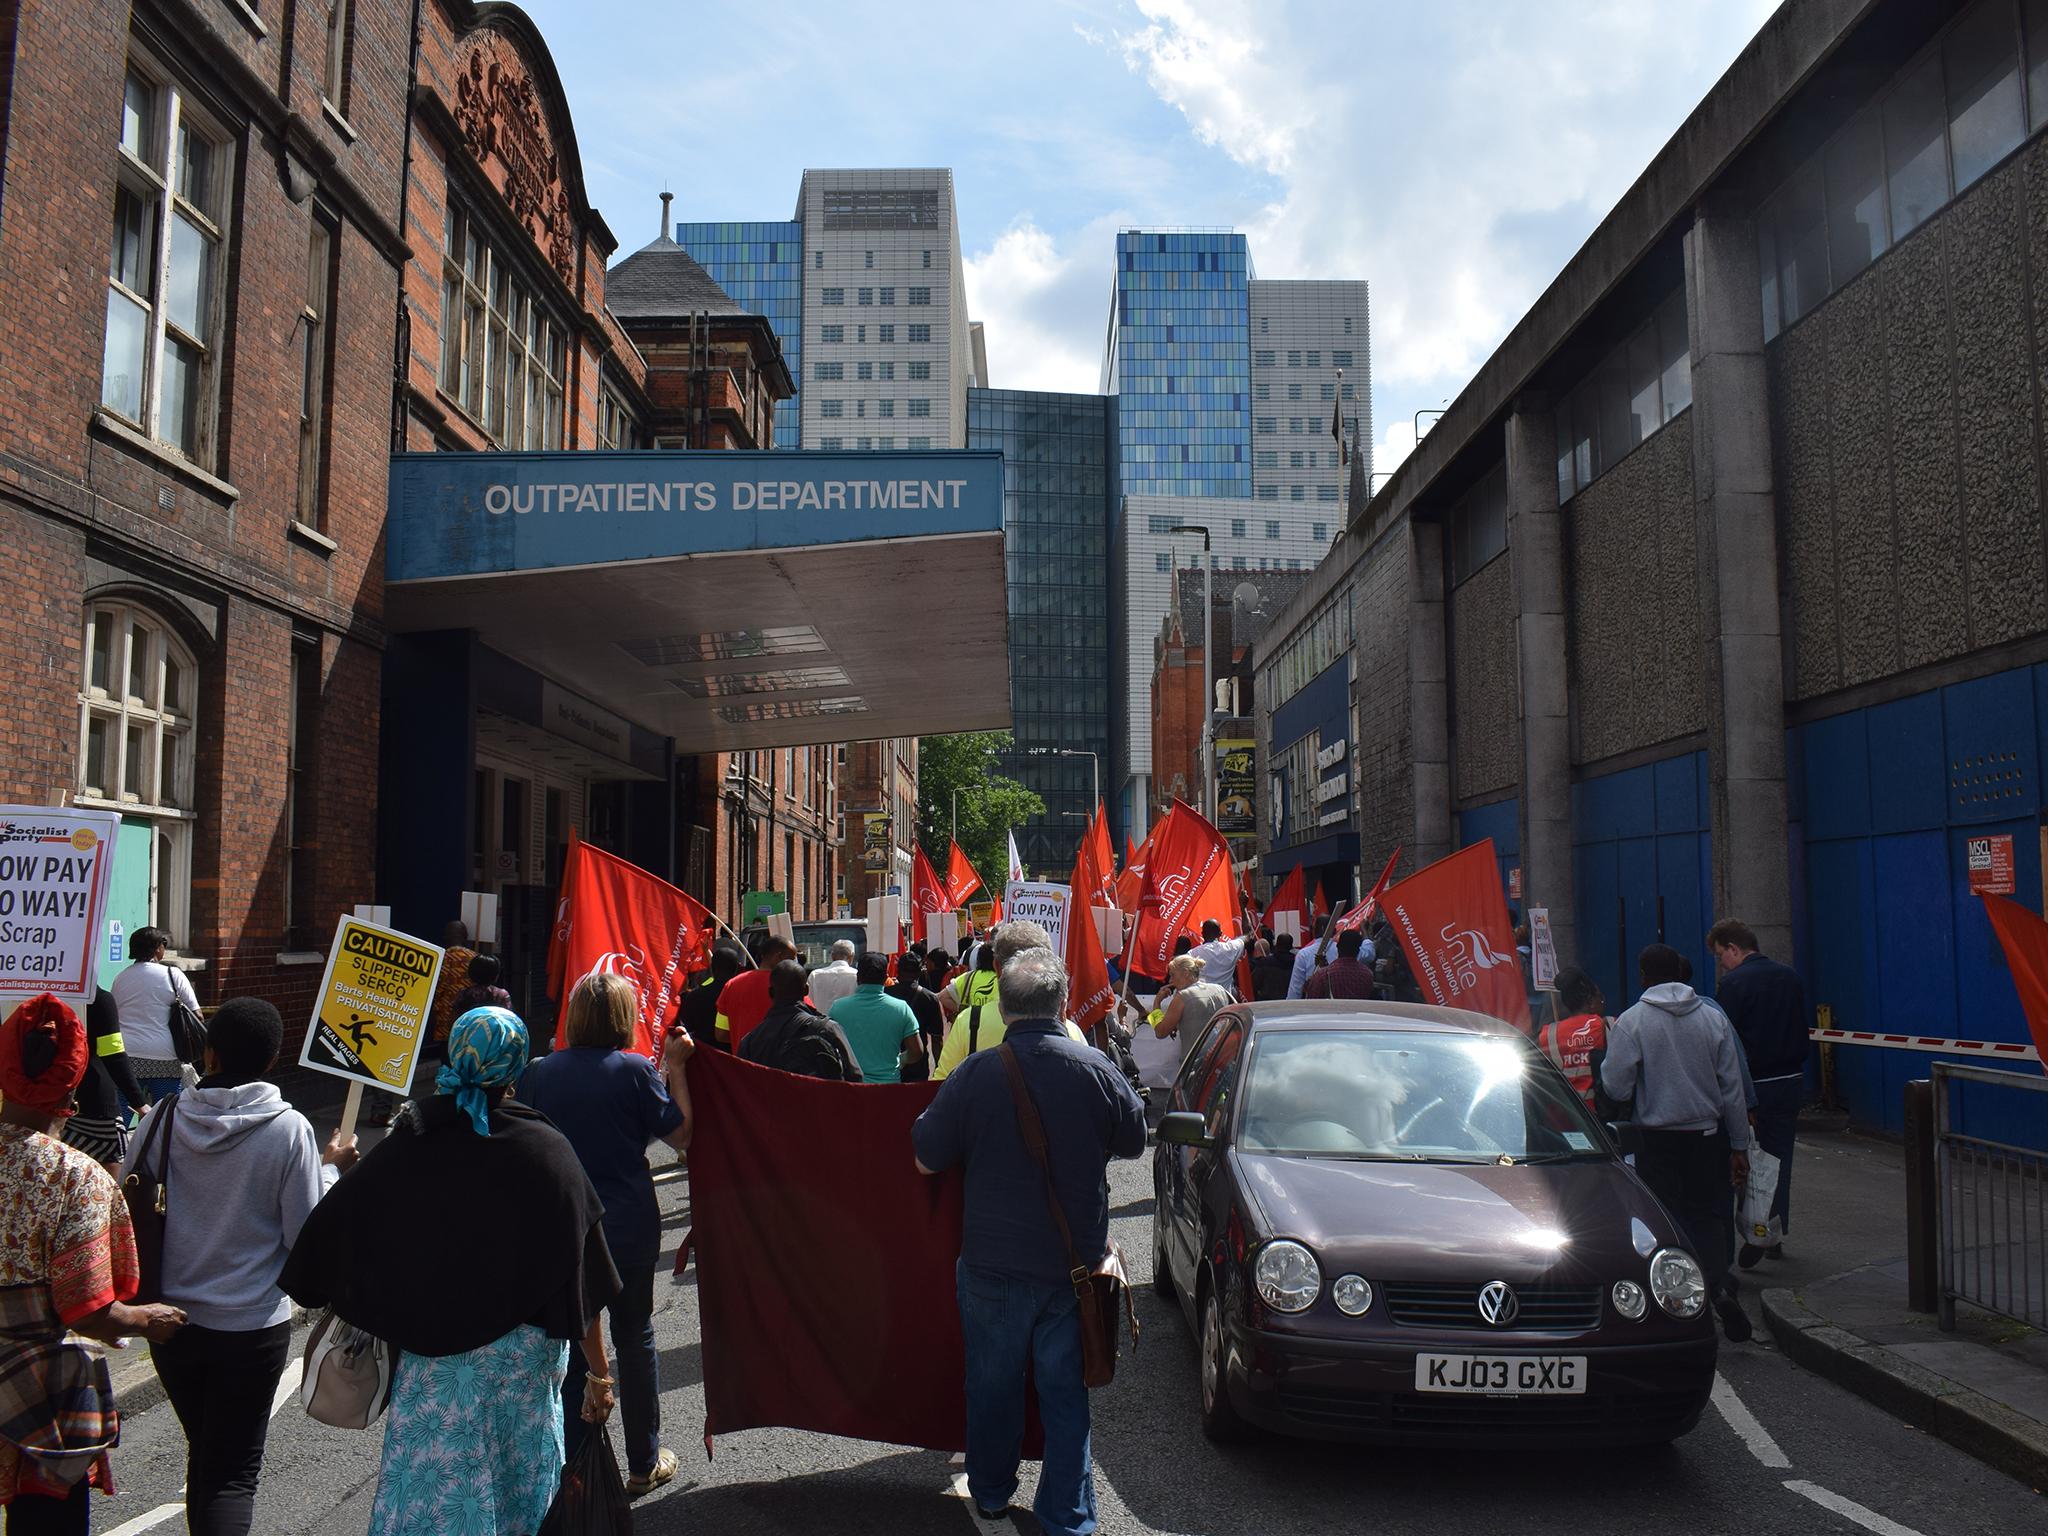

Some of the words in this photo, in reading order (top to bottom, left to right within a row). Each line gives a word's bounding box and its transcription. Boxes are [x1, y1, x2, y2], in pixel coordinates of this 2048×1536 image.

[484, 481, 716, 514] OUTPATIENTS
[733, 480, 967, 511] DEPARTMENT
[1225, 760, 1244, 771] PAY
[4, 823, 69, 836] Socialist
[1968, 840, 1991, 857] MSCL
[0, 856, 39, 881] OW
[43, 857, 93, 883] PAY
[0, 890, 15, 916] O
[22, 890, 87, 918] WAY!
[1012, 903, 1037, 915] LOW
[1040, 904, 1062, 917] PAY
[0, 921, 57, 949] Scrap
[21, 951, 65, 977] cap!
[349, 932, 431, 973] CAUTION
[1395, 904, 1449, 1006] www.unitetheuni
[1440, 922, 1477, 991] unite
[0, 980, 80, 991] cialistparty.org.uk
[352, 956, 419, 988] SLIPPERY
[358, 973, 406, 999] SERCO
[335, 982, 363, 999] Barts
[366, 991, 398, 1008] Health
[399, 1002, 419, 1016] NHS
[336, 996, 416, 1028] PRIVATISATION
[375, 1020, 413, 1039] AHEAD
[1567, 1035, 1594, 1048] unite
[321, 1025, 337, 1044] REAL
[337, 1041, 360, 1065] WAGES
[1429, 1359, 1509, 1389] KJ03
[1518, 1361, 1575, 1389] GXG
